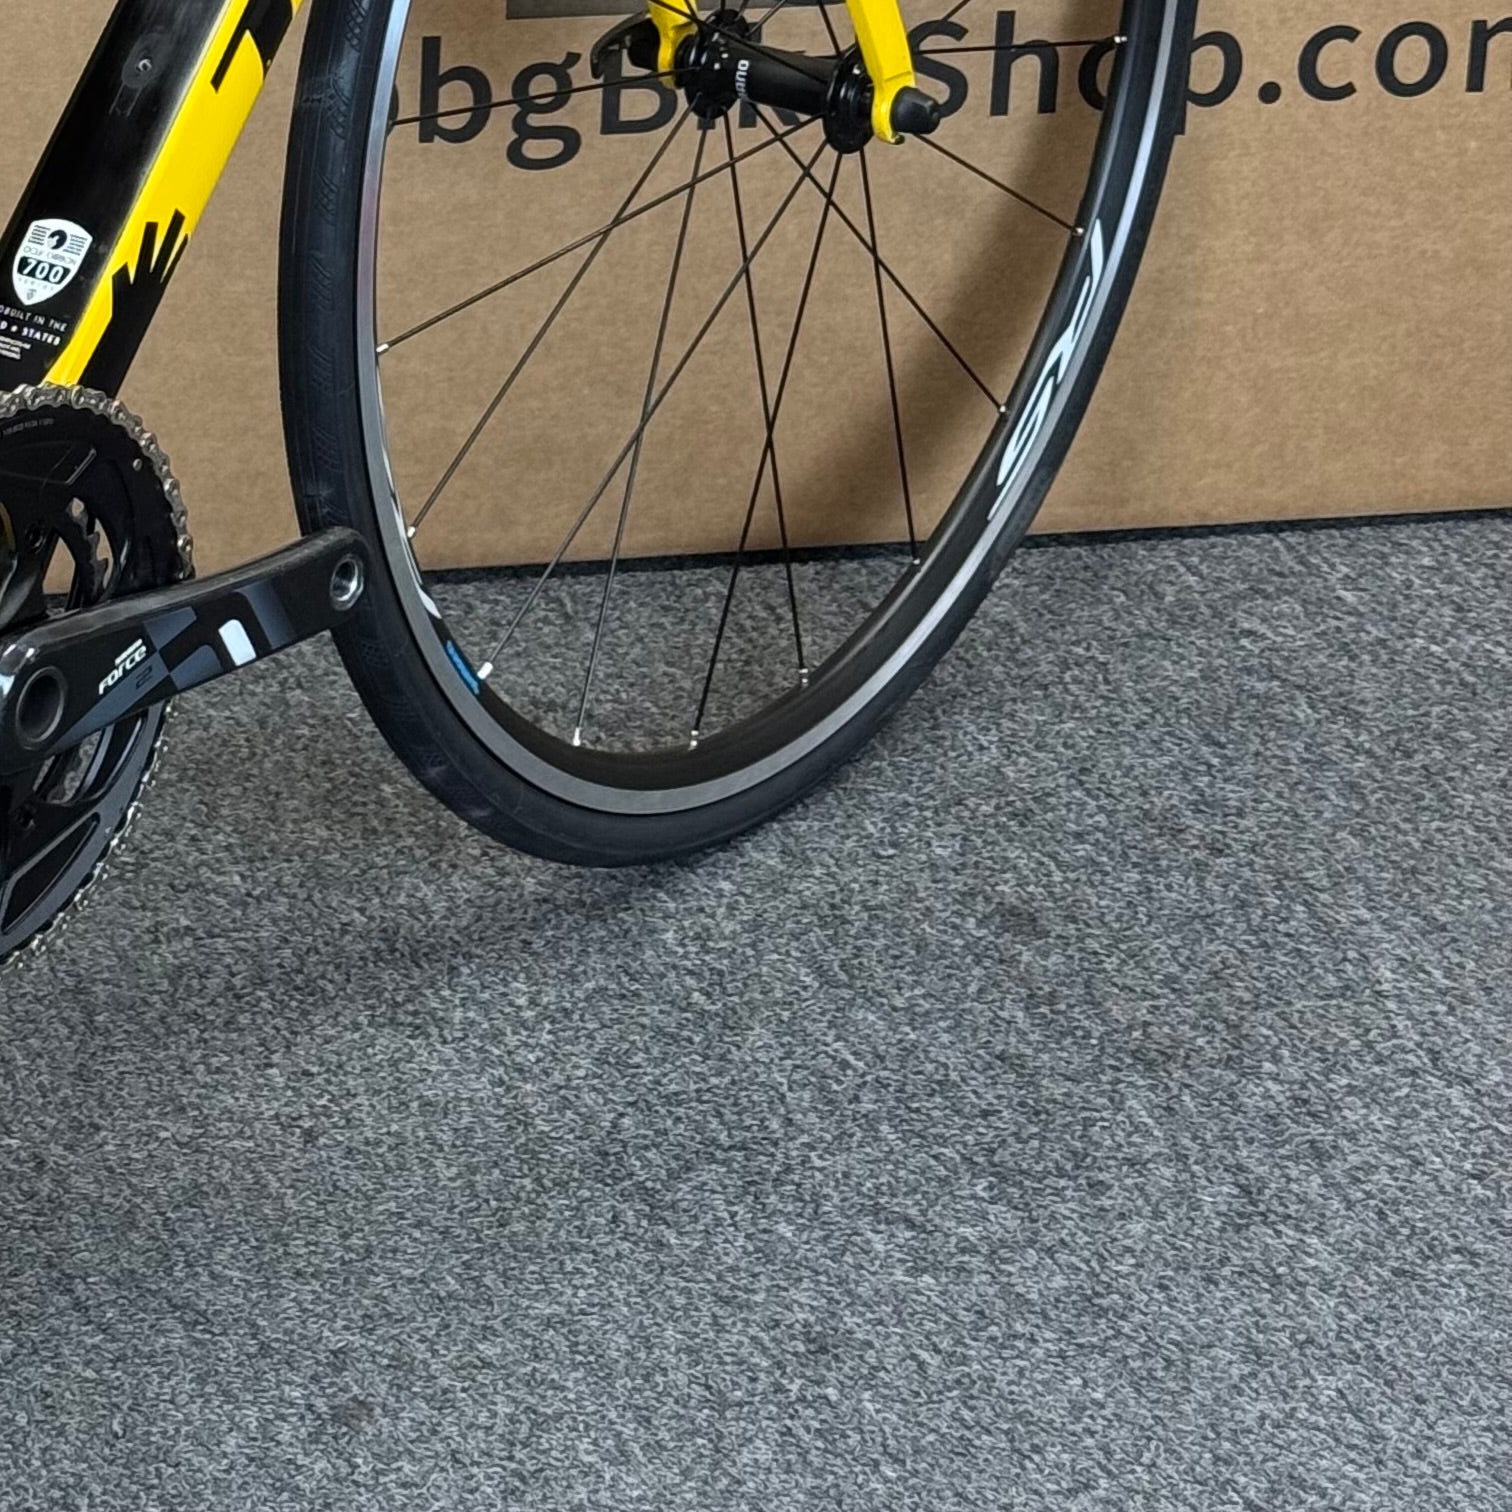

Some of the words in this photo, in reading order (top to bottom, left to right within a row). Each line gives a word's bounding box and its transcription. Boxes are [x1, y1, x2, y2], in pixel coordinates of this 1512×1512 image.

[21, 258, 65, 284] 700
[33, 314, 46, 326] IN
[49, 318, 68, 332] THE
[21, 326, 62, 346] STATES
[98, 644, 148, 696] Force
